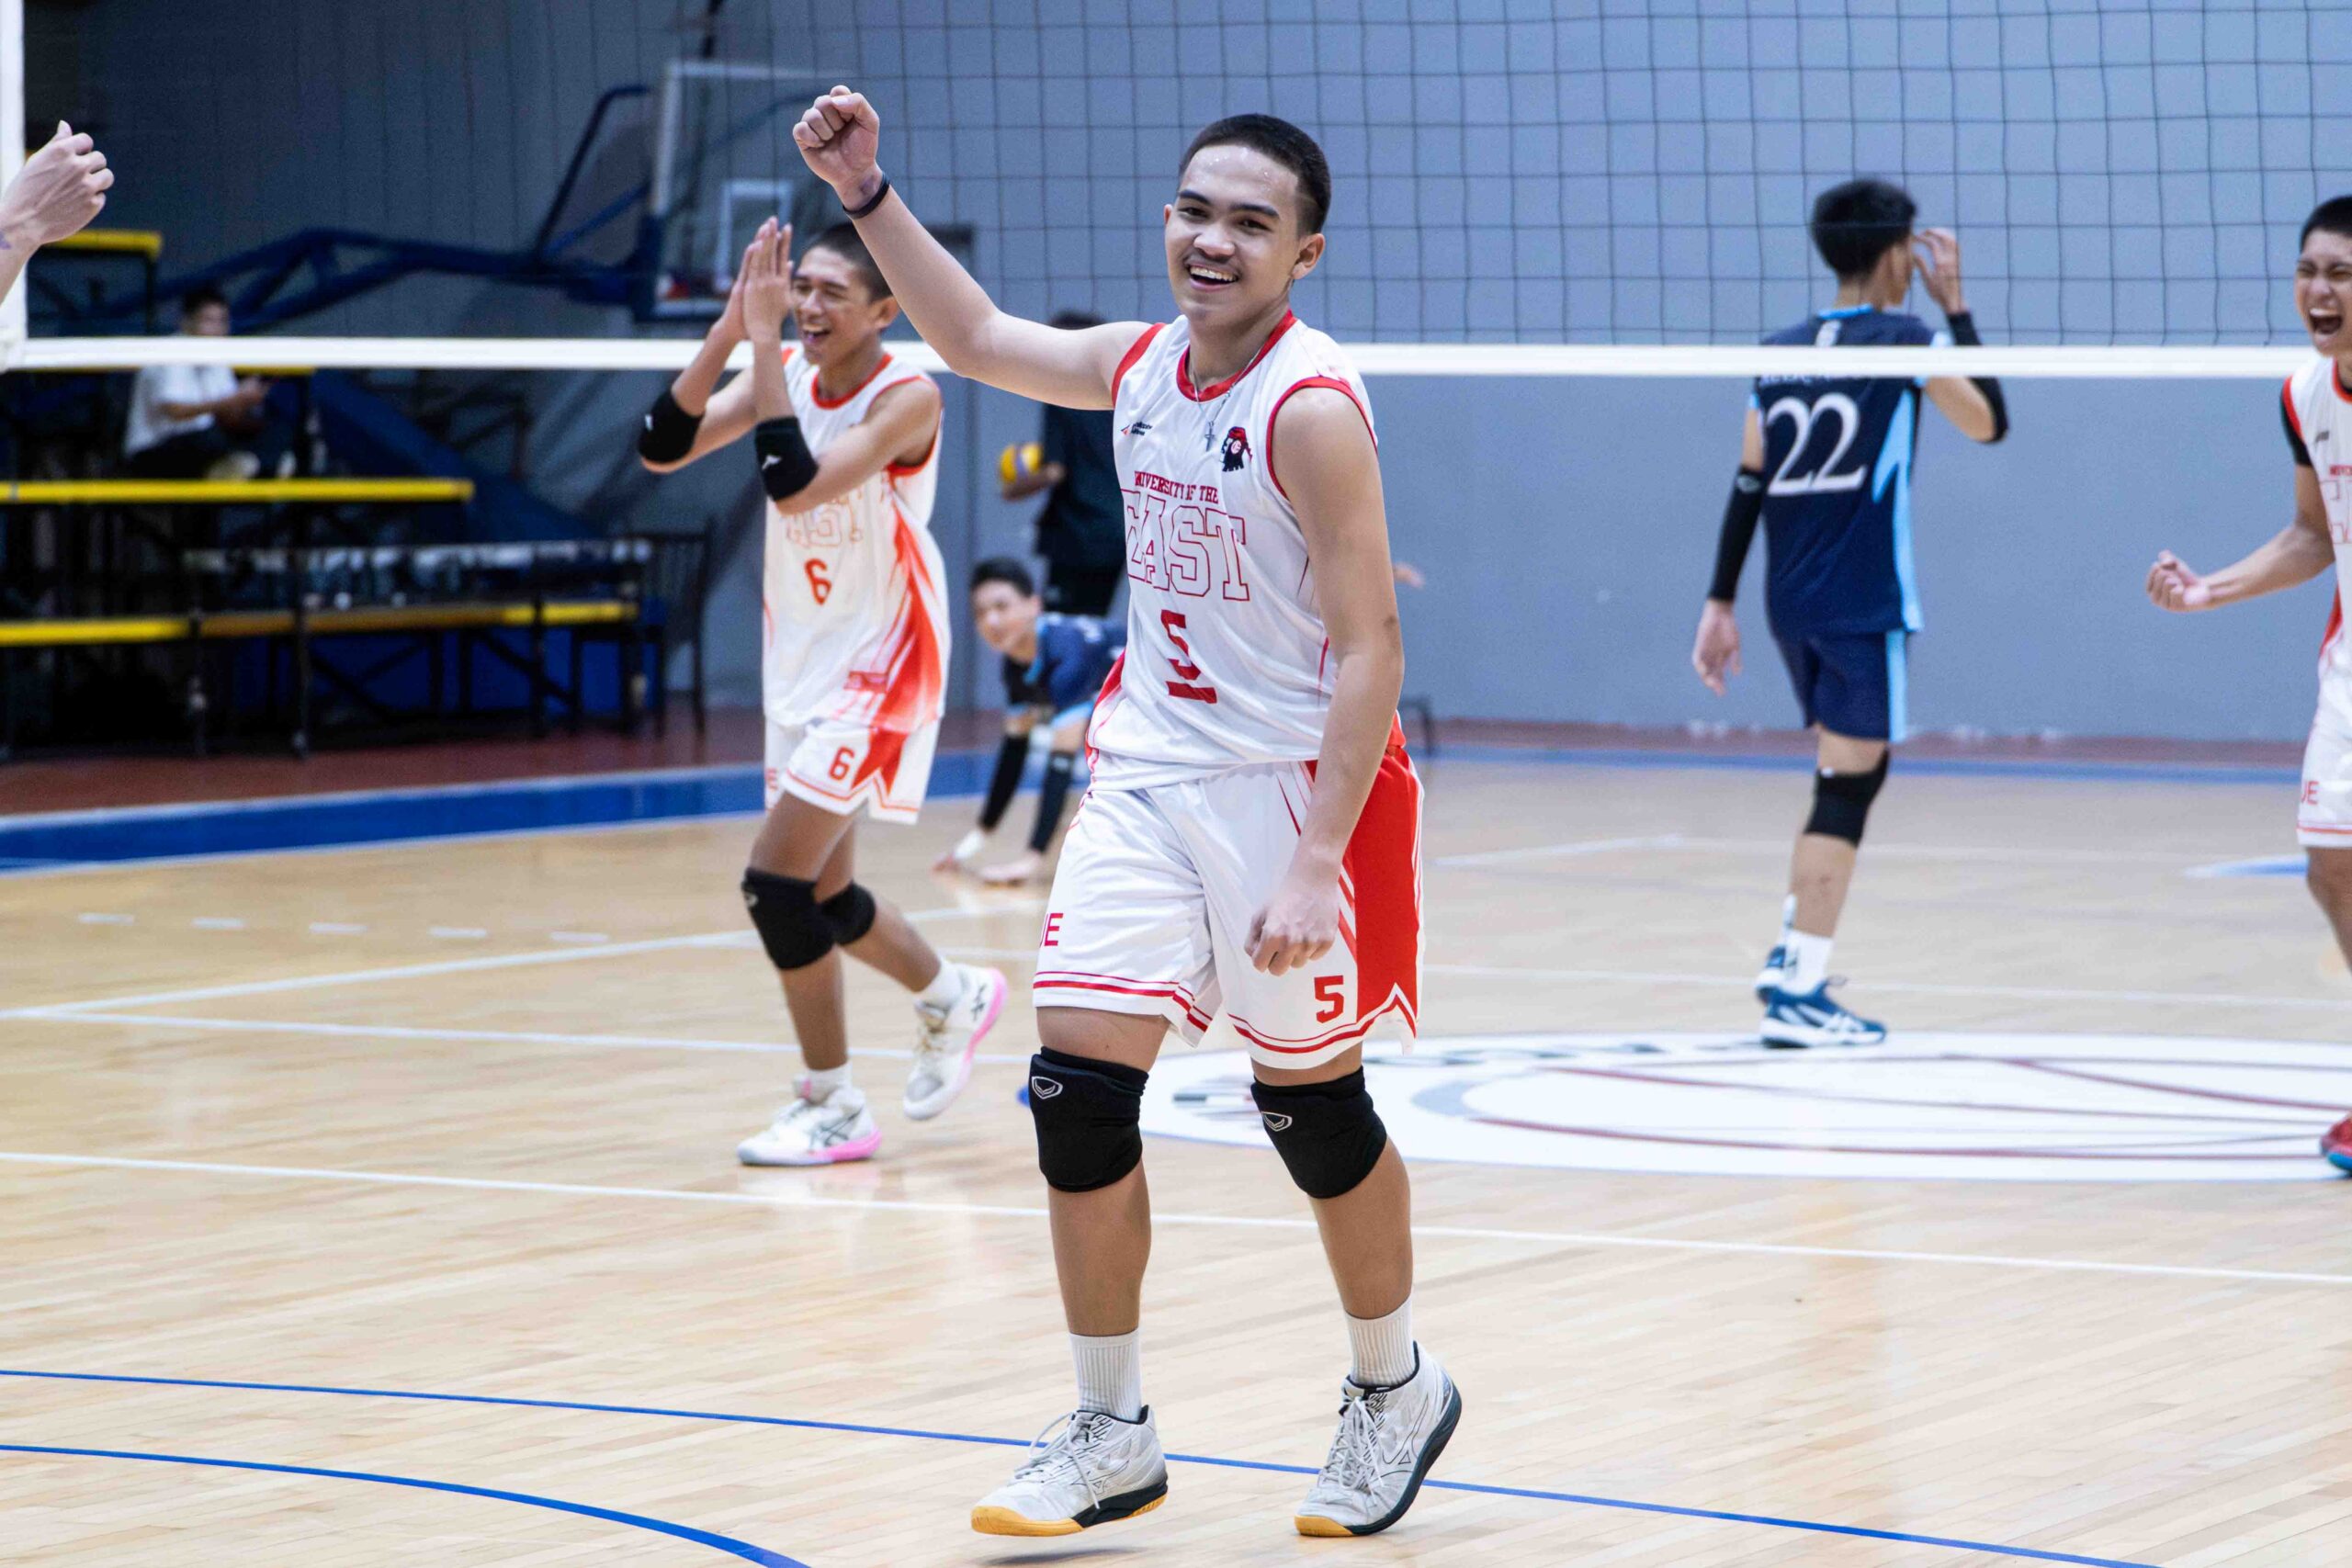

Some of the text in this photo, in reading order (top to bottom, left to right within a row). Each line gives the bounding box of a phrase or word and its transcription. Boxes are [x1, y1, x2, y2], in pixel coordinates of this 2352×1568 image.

[1766, 392, 1867, 497] 22
[1199, 485, 1219, 504] THE
[803, 558, 832, 606] 6
[1159, 609, 1218, 705] 5
[828, 746, 855, 781] 6
[1039, 912, 1064, 948] E
[1313, 974, 1345, 1024] 5
